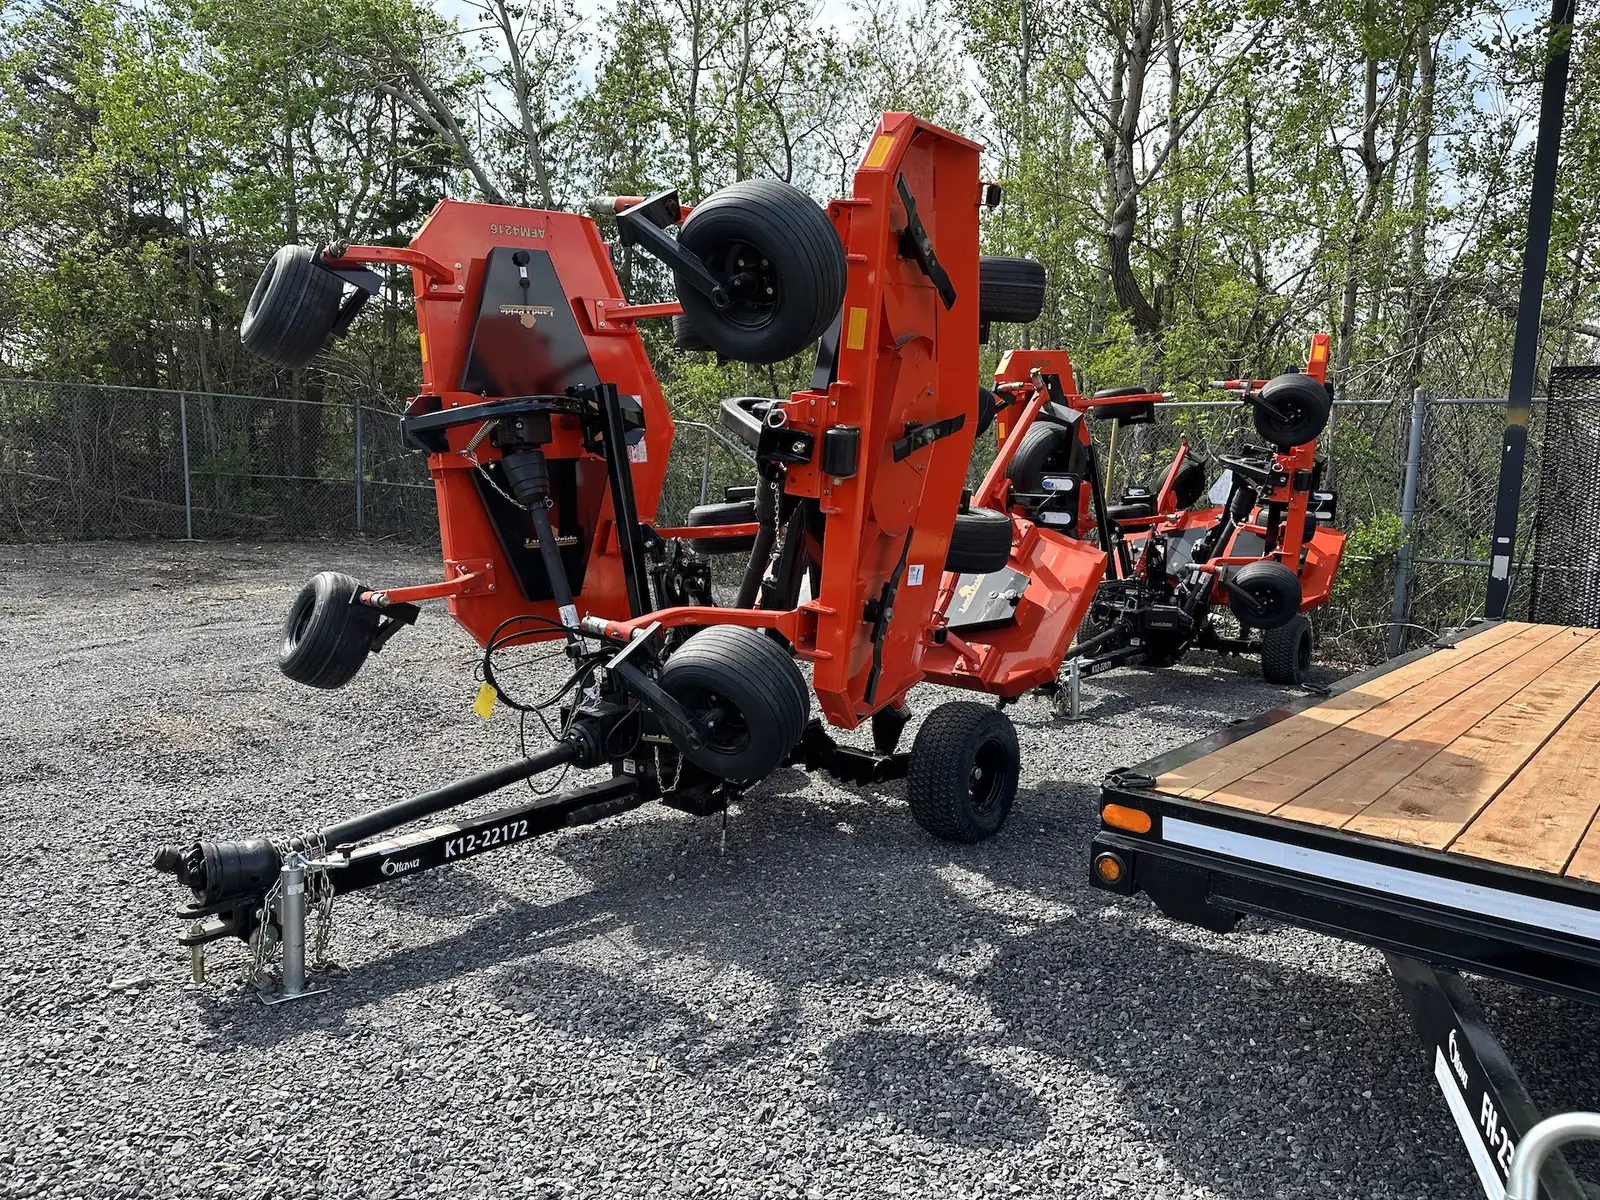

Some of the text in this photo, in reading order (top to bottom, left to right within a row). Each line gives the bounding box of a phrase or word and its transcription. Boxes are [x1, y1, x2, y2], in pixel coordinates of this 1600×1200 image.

[490, 223, 546, 239] AFM4216
[381, 858, 420, 876] Ottawa
[445, 819, 528, 858] K12-22172
[1449, 1029, 1469, 1090] Ottawa
